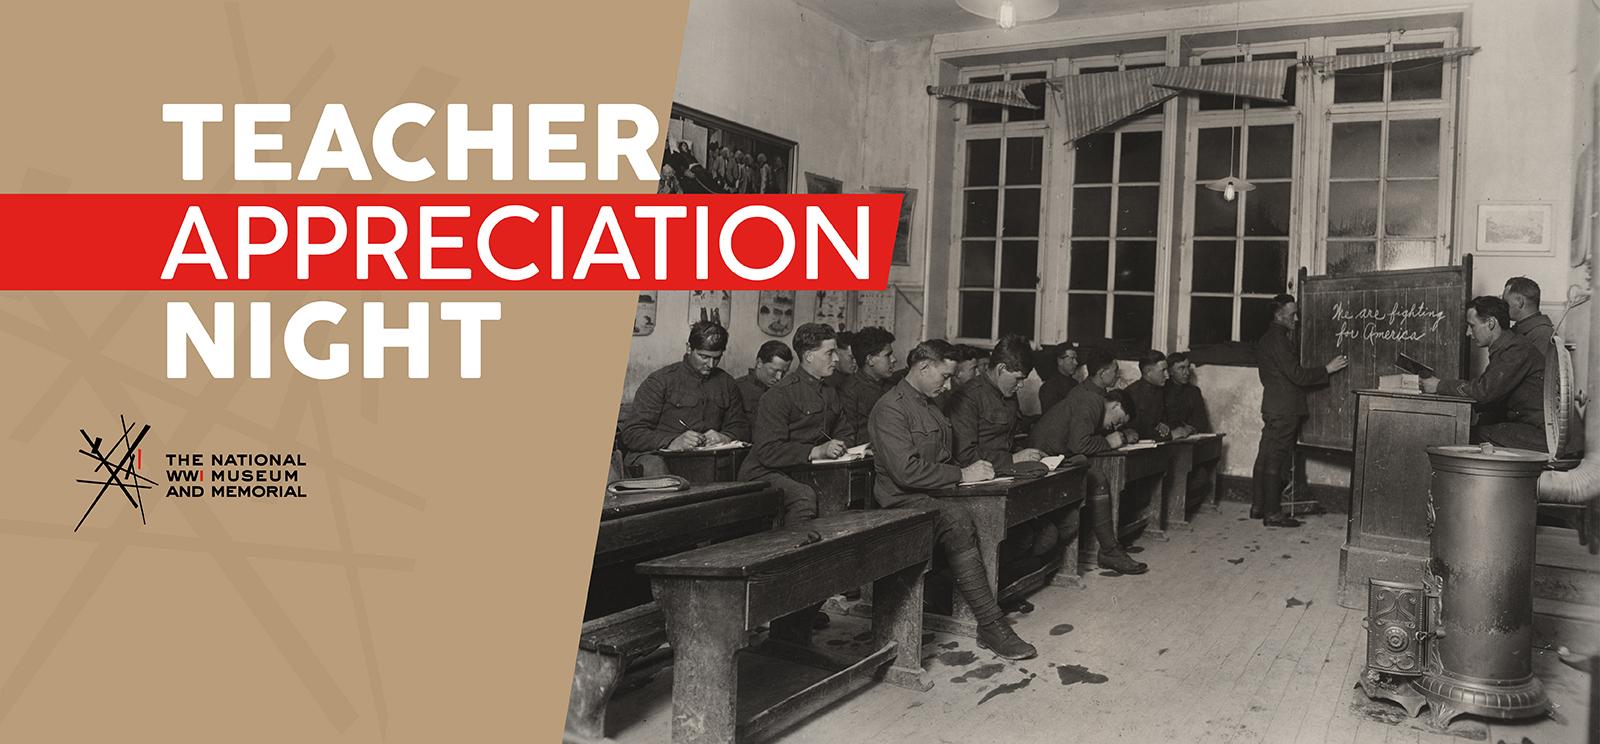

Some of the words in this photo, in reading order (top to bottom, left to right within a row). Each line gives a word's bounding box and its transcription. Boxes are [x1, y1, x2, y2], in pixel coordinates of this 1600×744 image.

[1332, 301, 1353, 320] We
[1355, 308, 1385, 320] are
[1386, 301, 1446, 331] fighting
[1335, 322, 1359, 348] for
[1363, 323, 1426, 346] America
